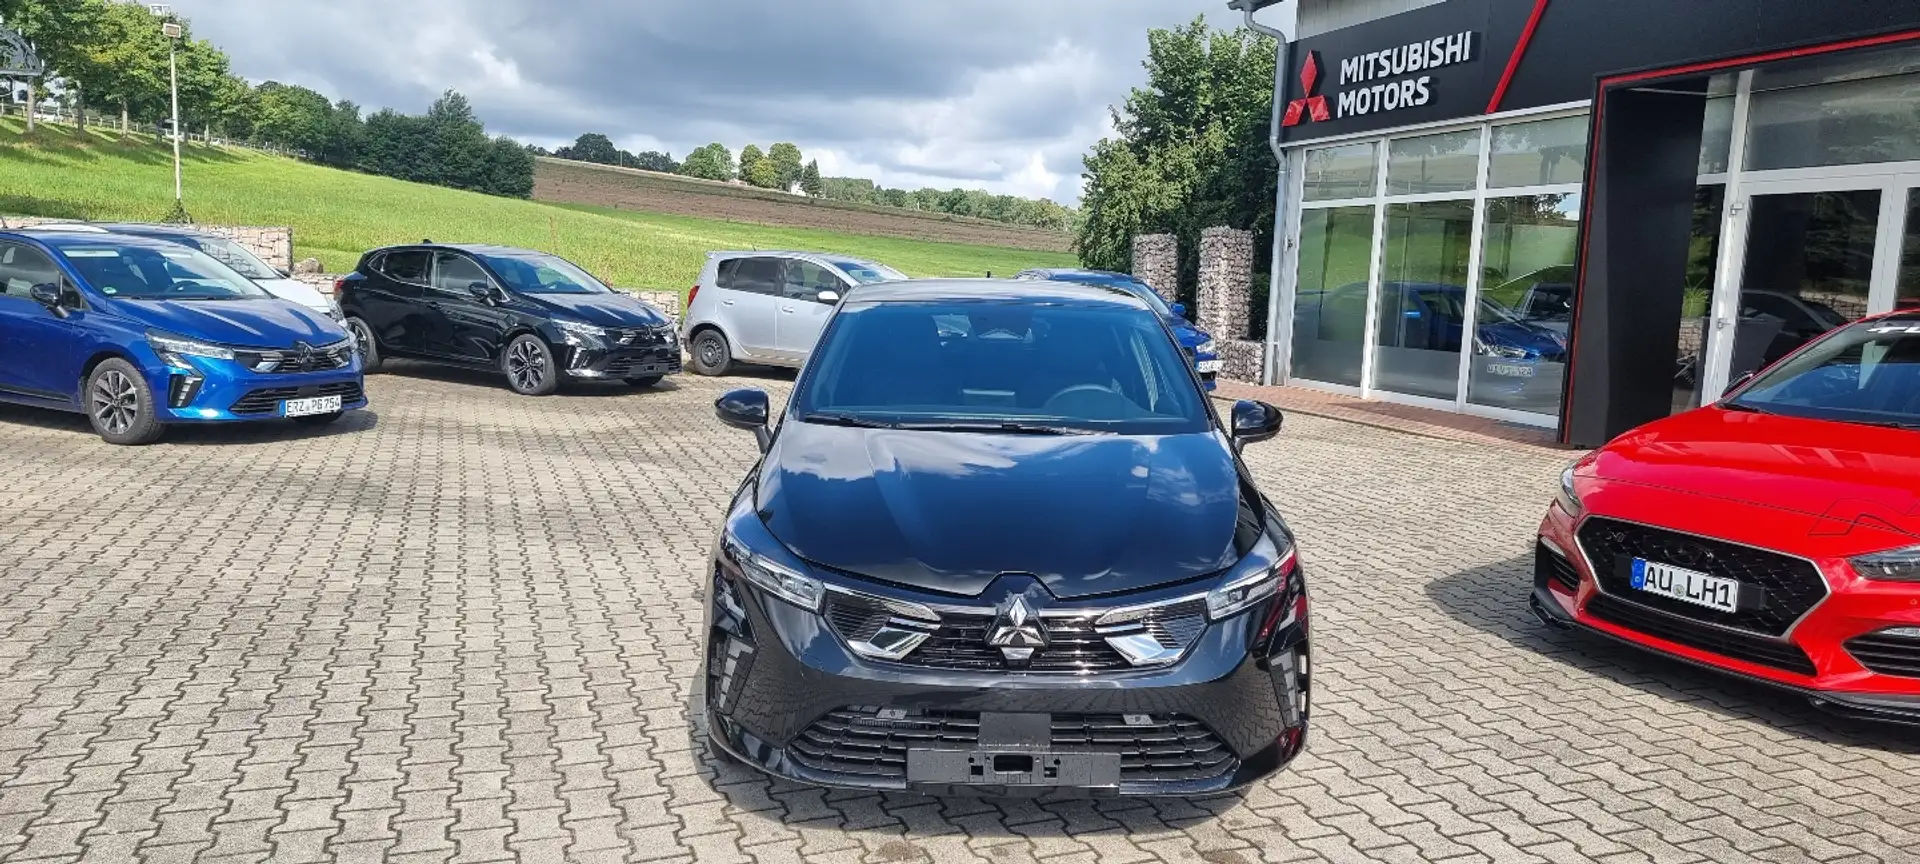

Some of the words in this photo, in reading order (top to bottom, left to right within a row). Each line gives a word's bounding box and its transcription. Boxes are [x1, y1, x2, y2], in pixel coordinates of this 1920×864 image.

[1339, 31, 1472, 85] MITSUBISHI
[1337, 76, 1431, 118] MOTORS
[286, 401, 304, 413] ERZ
[1644, 566, 1674, 593] AU
[1685, 574, 1732, 608] LH1
